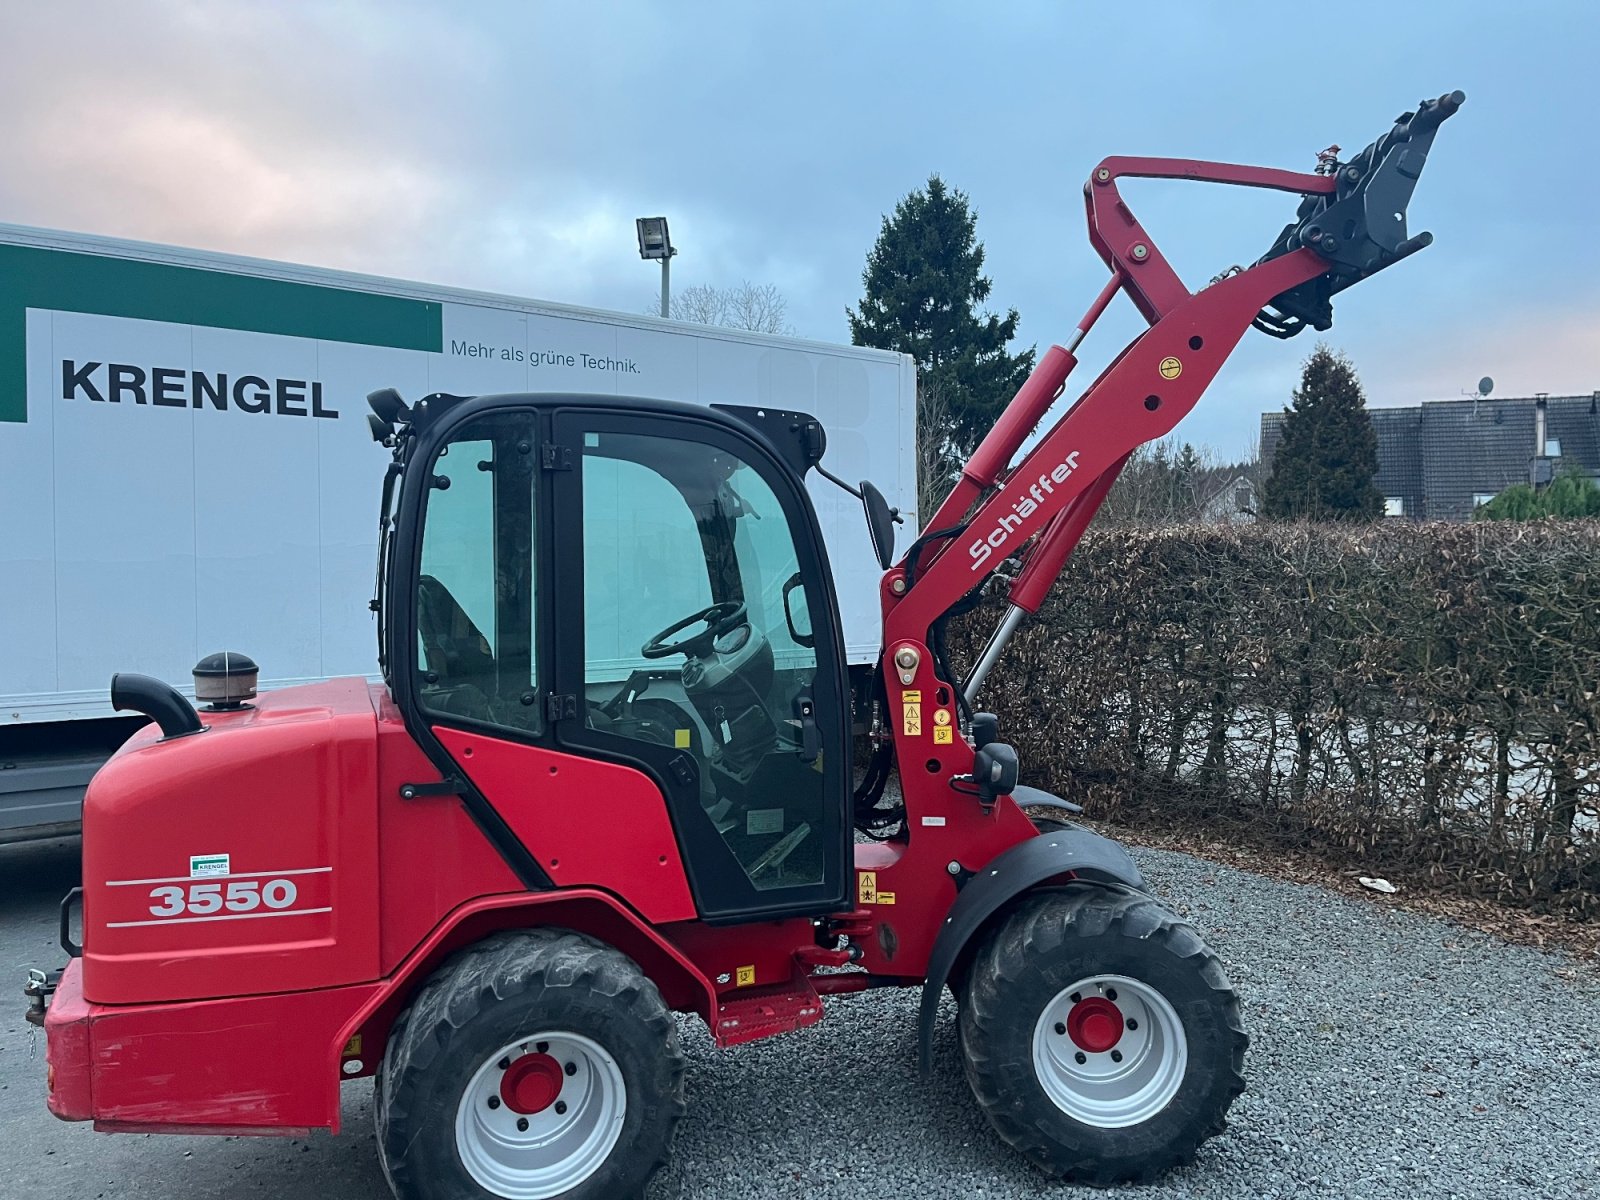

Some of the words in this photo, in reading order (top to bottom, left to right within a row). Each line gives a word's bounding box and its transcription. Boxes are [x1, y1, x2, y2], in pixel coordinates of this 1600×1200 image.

[451, 340, 495, 358] Mehr
[501, 347, 524, 362] als
[530, 351, 575, 367] grüne
[580, 354, 641, 374] Technik.
[62, 359, 339, 419] KRENGEL
[969, 450, 1080, 571] Schäffer
[149, 879, 297, 917] 3550
